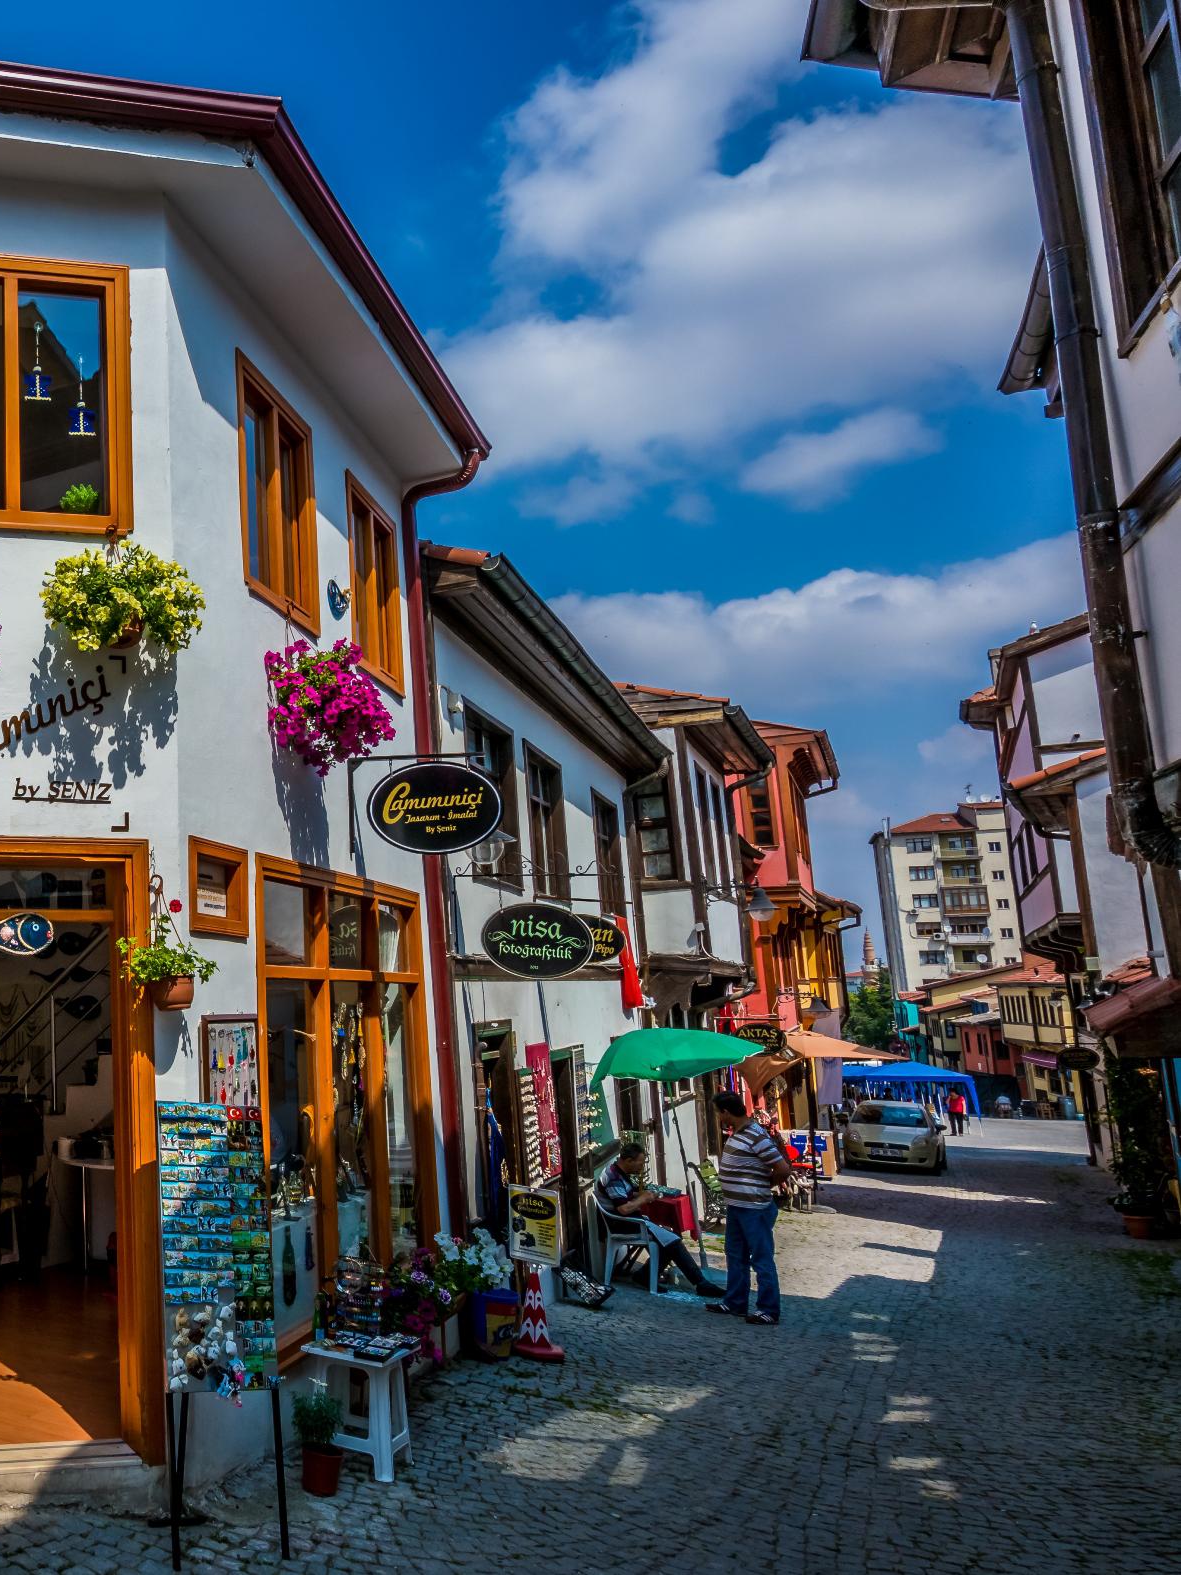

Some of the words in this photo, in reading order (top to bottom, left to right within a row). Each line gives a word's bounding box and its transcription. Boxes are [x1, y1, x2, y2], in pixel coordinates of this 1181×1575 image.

[14, 777, 40, 803] by
[425, 826, 435, 834] By
[509, 914, 563, 940] nisa
[498, 940, 573, 960] fotoğrafçılık
[595, 943, 615, 957] Pipo
[738, 1028, 778, 1039] AKTAŞ
